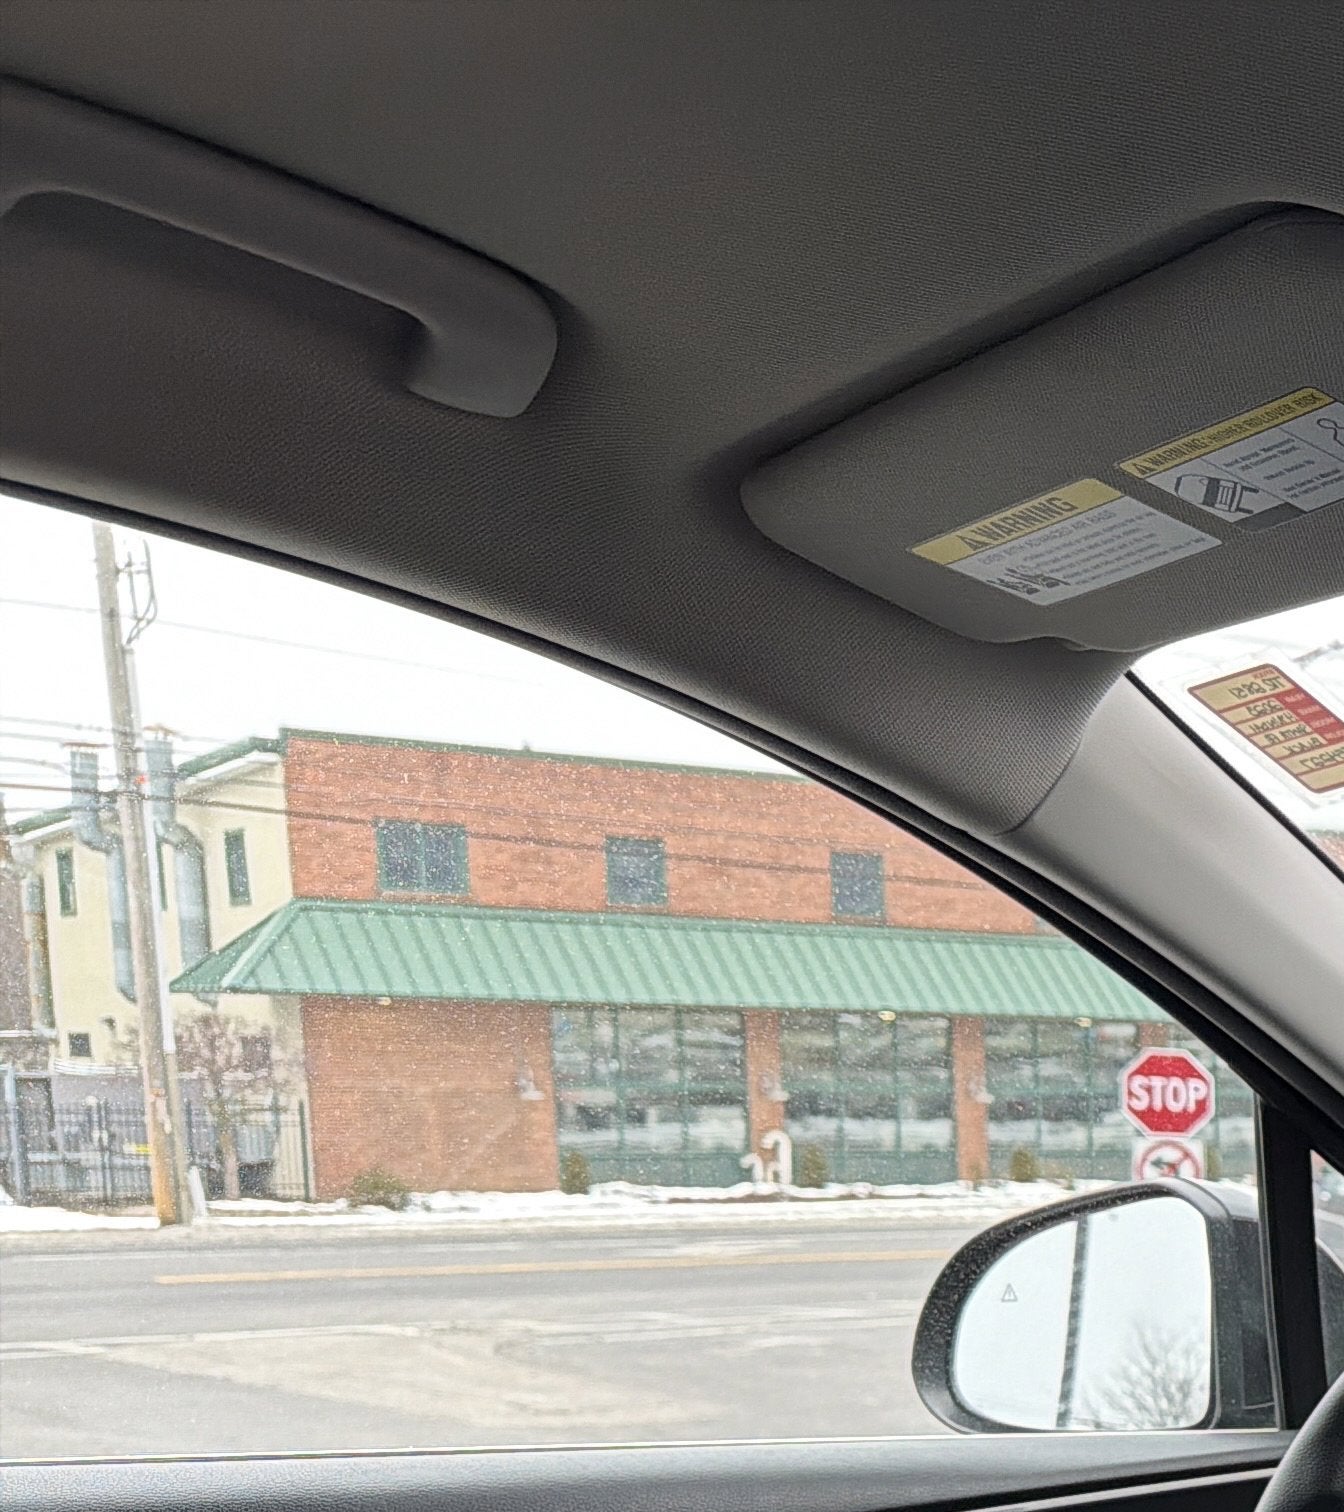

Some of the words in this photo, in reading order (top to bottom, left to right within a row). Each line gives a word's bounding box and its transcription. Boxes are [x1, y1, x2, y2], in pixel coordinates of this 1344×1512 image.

[1288, 391, 1325, 408] RISK
[967, 495, 1080, 542] WARNING
[1128, 1074, 1207, 1114] STOP
